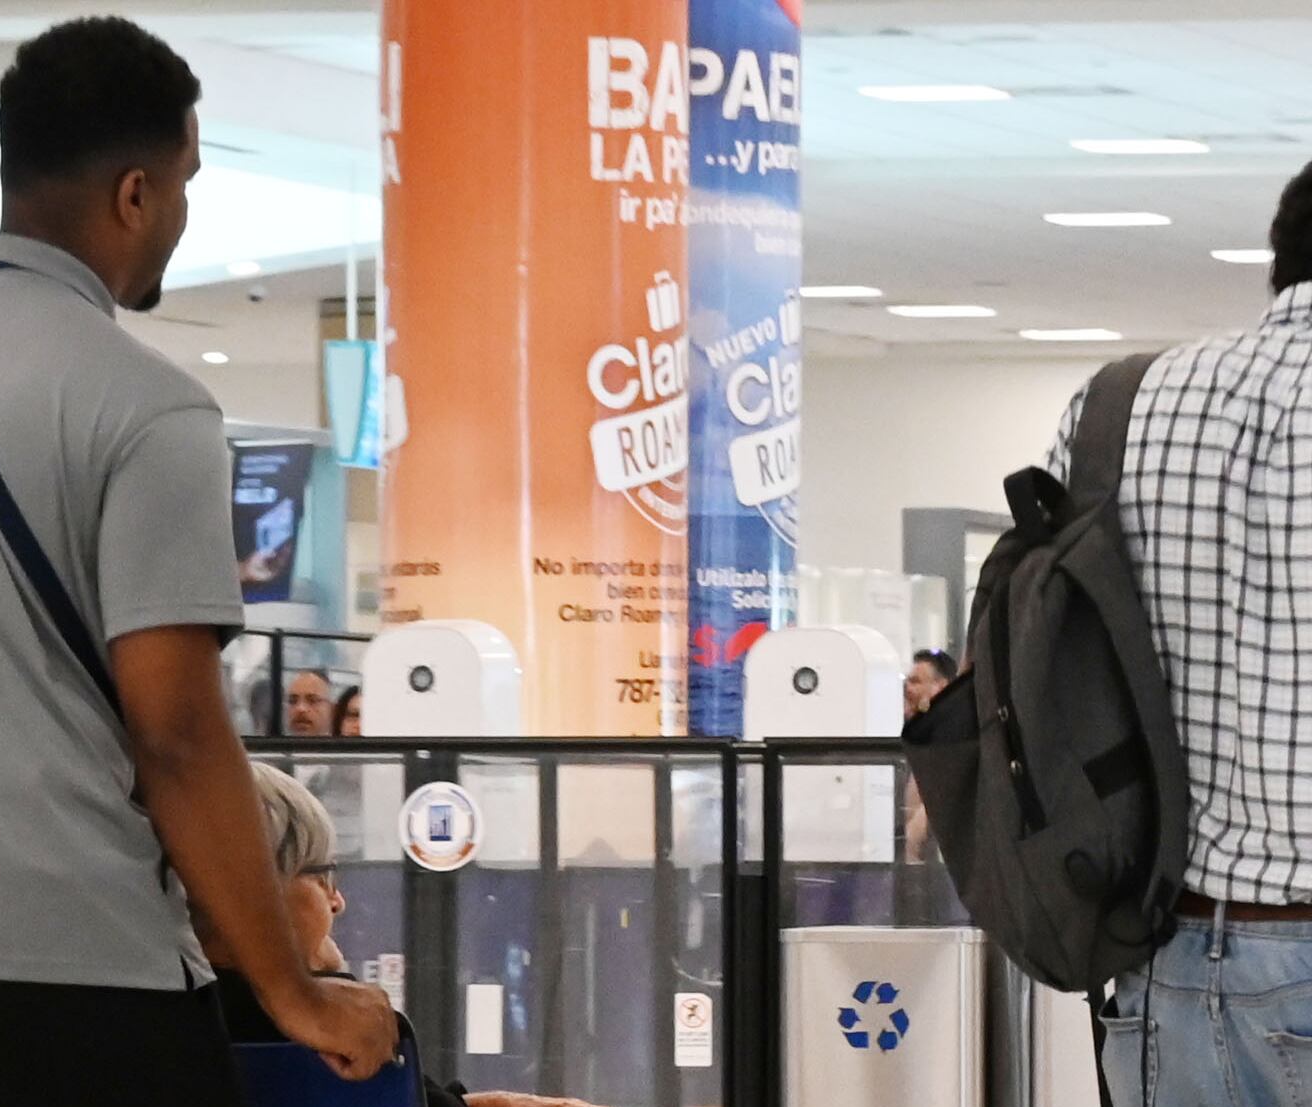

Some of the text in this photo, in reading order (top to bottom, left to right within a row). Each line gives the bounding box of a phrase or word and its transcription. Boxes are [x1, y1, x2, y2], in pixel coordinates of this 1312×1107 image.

[588, 36, 688, 133] BA
[591, 132, 654, 182] LA
[705, 316, 777, 369] NUEVO
[533, 557, 564, 576] No
[570, 556, 645, 578] importa
[558, 603, 614, 622] Claro
